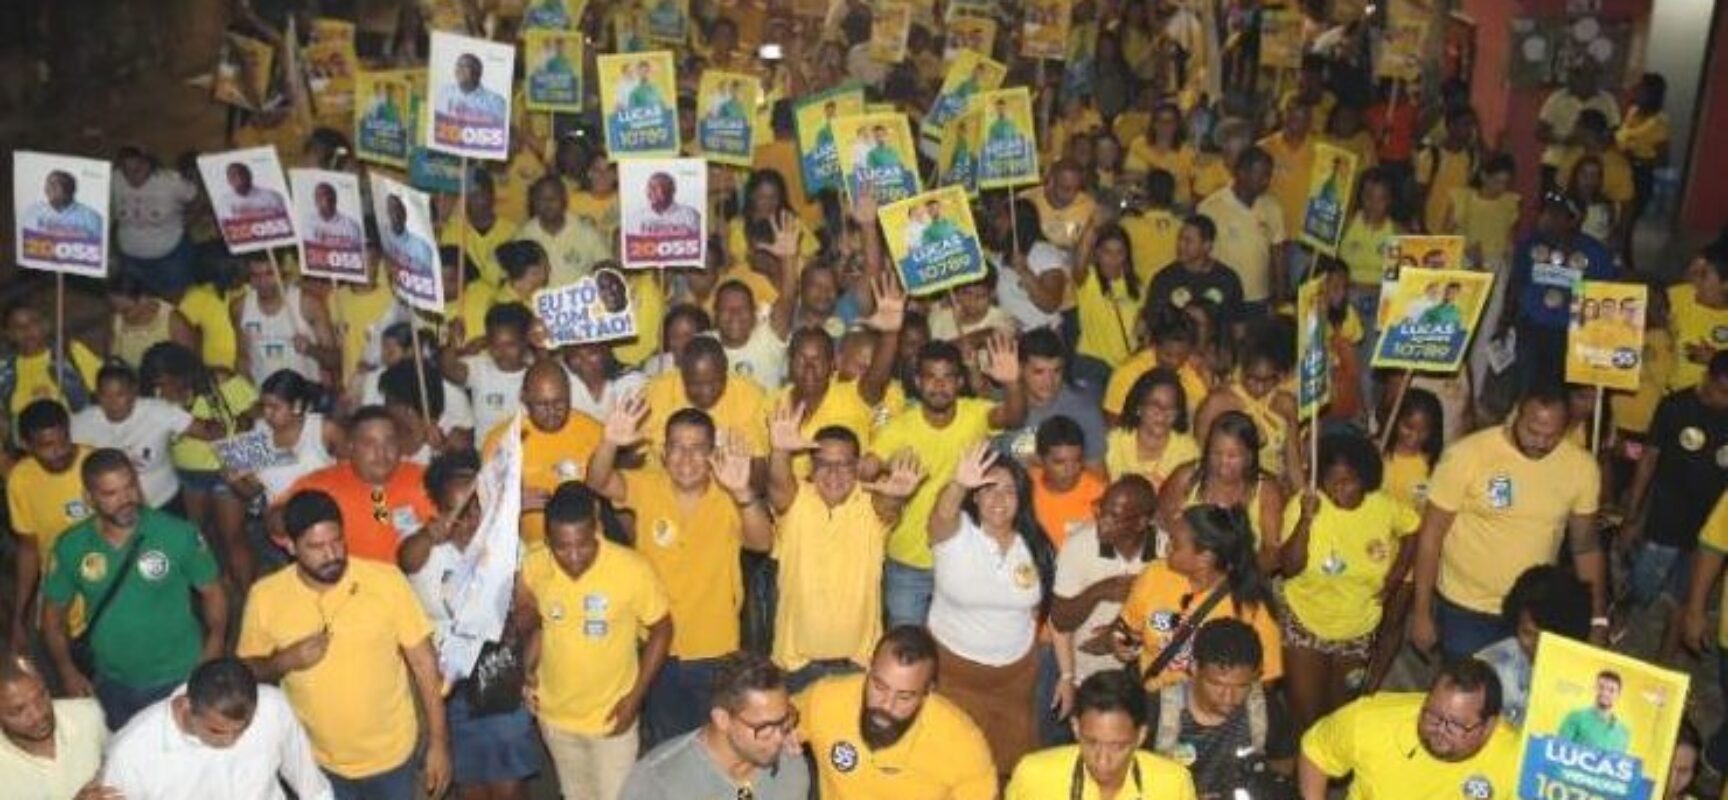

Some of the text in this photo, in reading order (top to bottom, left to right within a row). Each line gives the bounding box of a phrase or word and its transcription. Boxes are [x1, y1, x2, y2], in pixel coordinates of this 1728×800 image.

[629, 239, 699, 257] 20055
[912, 234, 962, 262] LUCAS
[539, 292, 564, 314] EU
[1401, 324, 1455, 334] LUCAS
[1545, 738, 1634, 783] LUCAS
